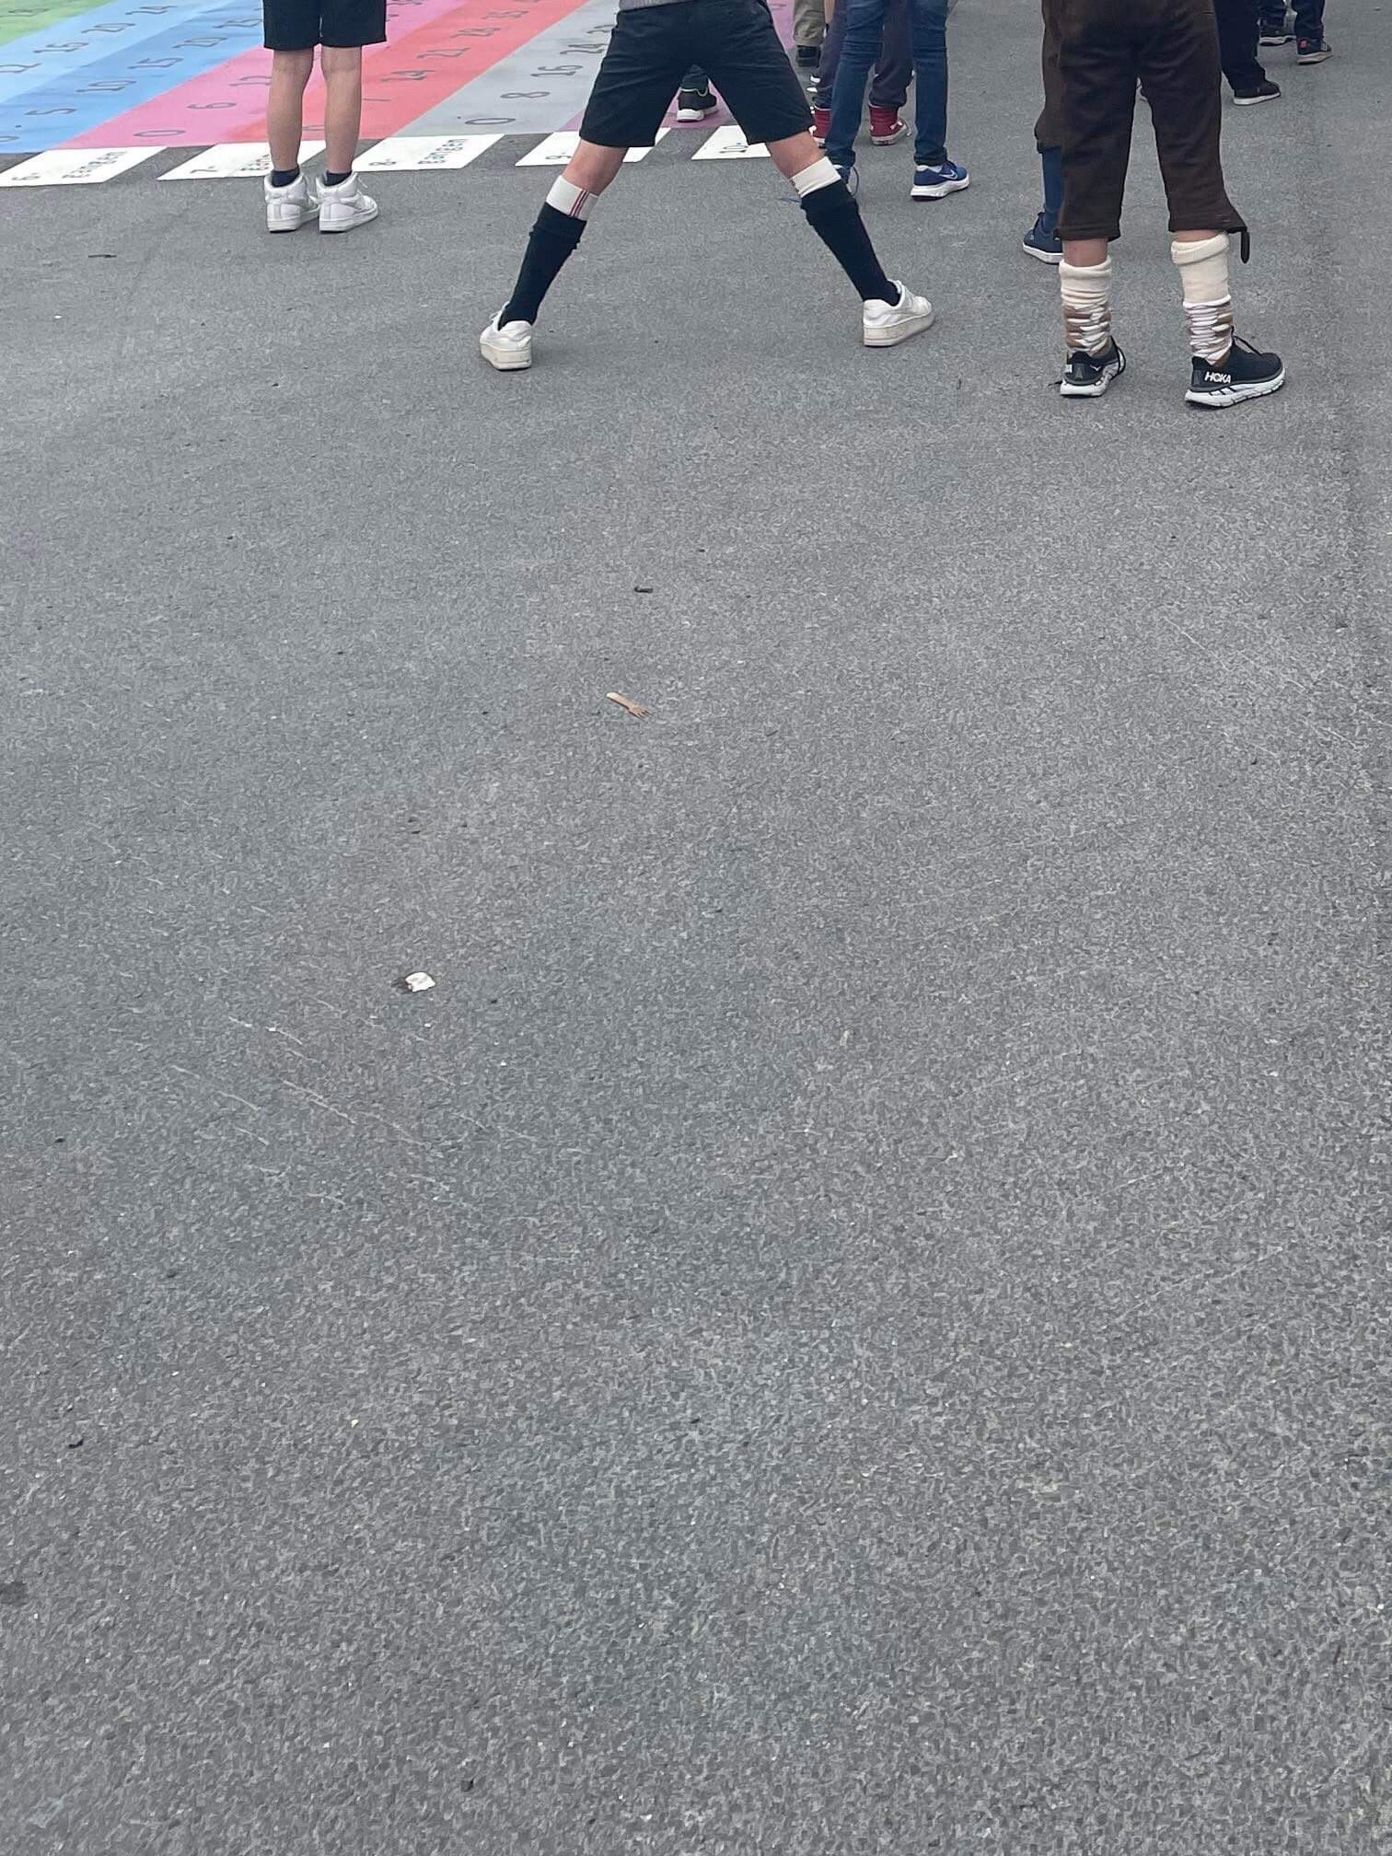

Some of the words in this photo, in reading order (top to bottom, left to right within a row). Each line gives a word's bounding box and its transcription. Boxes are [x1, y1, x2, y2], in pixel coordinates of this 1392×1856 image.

[75, 80, 137, 94] 10
[127, 56, 184, 70] 15
[500, 90, 551, 100] 8
[530, 64, 584, 78] 16
[187, 101, 237, 110] 6
[1204, 371, 1231, 384] HOKA
